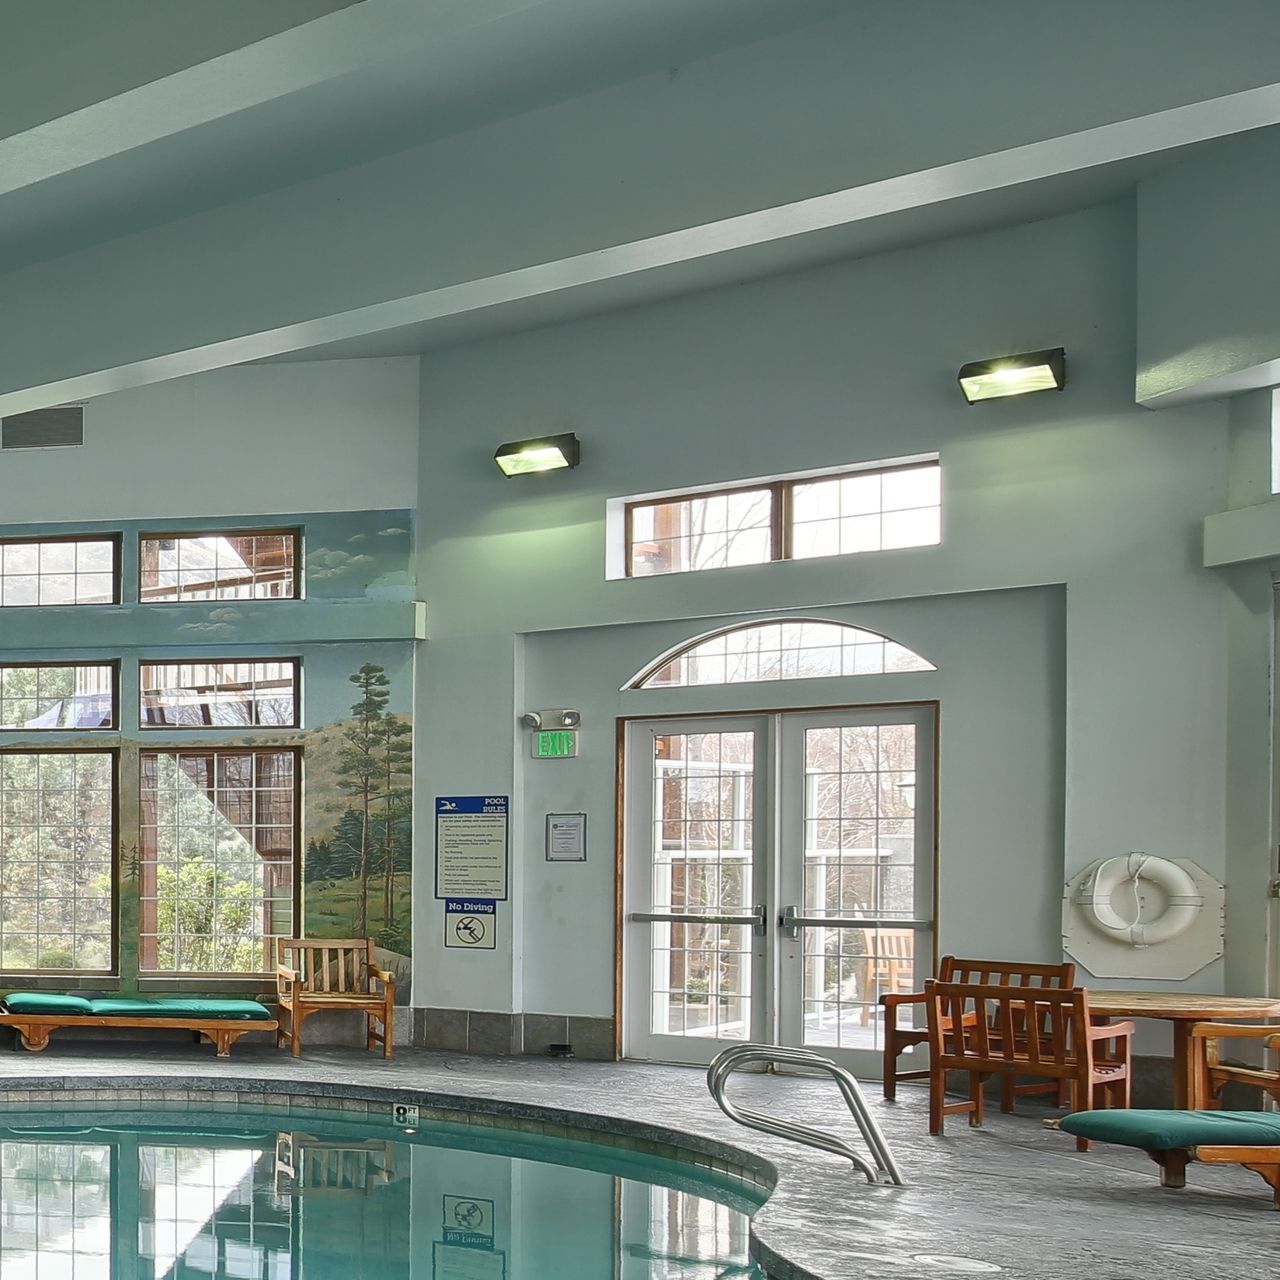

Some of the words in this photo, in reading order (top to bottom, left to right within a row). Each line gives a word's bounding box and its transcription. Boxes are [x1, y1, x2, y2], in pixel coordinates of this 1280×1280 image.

[538, 732, 571, 756] EXIT
[463, 903, 494, 913] Diving
[408, 1106, 417, 1114] FT
